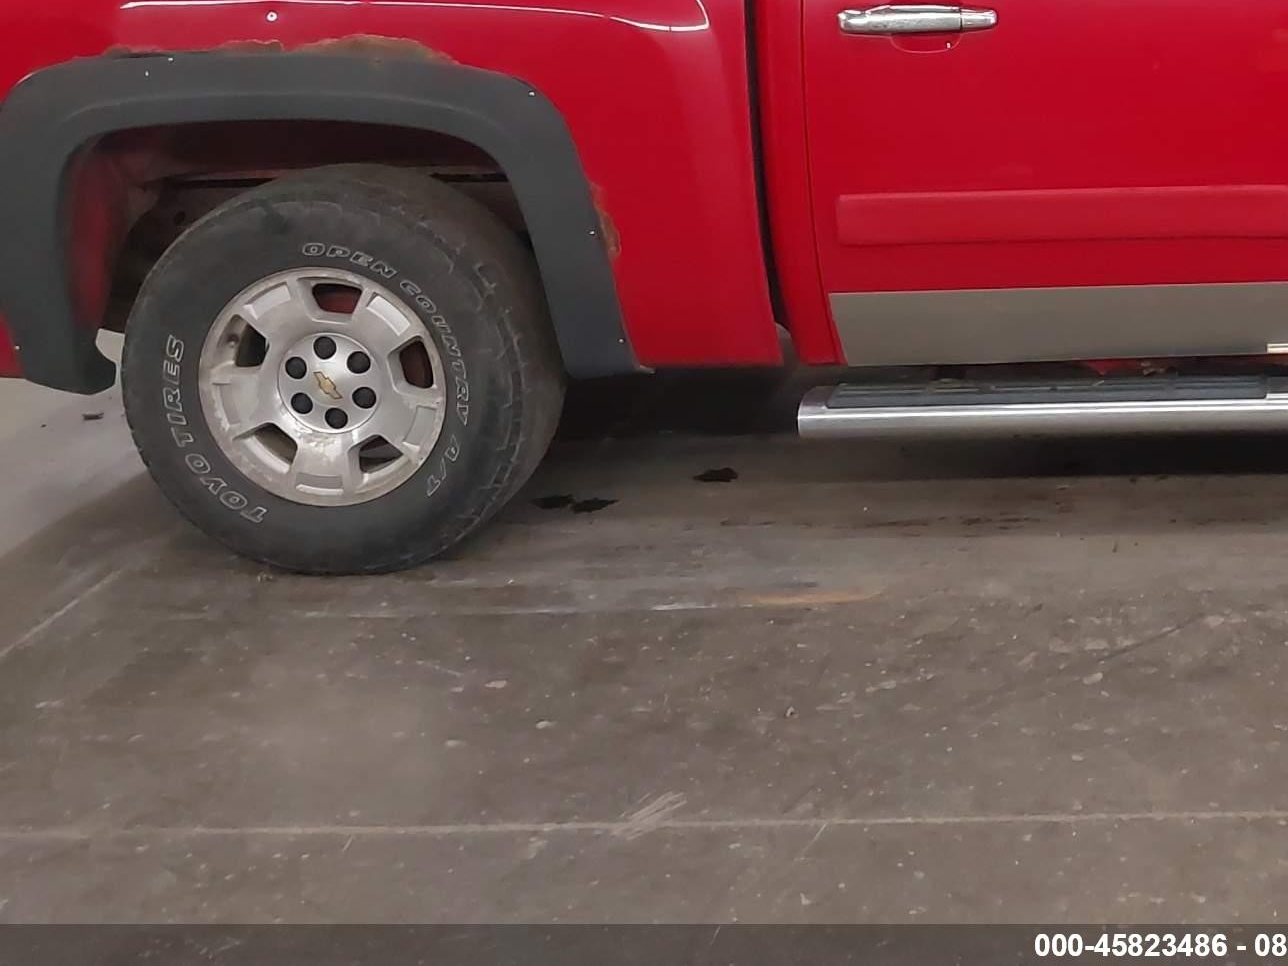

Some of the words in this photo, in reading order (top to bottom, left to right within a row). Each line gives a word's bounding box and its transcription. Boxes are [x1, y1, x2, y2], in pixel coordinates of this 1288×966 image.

[163, 334, 195, 448] TIRES
[302, 242, 398, 279] OPEN
[400, 279, 469, 426] COUNTRY
[184, 452, 269, 523] TOYO
